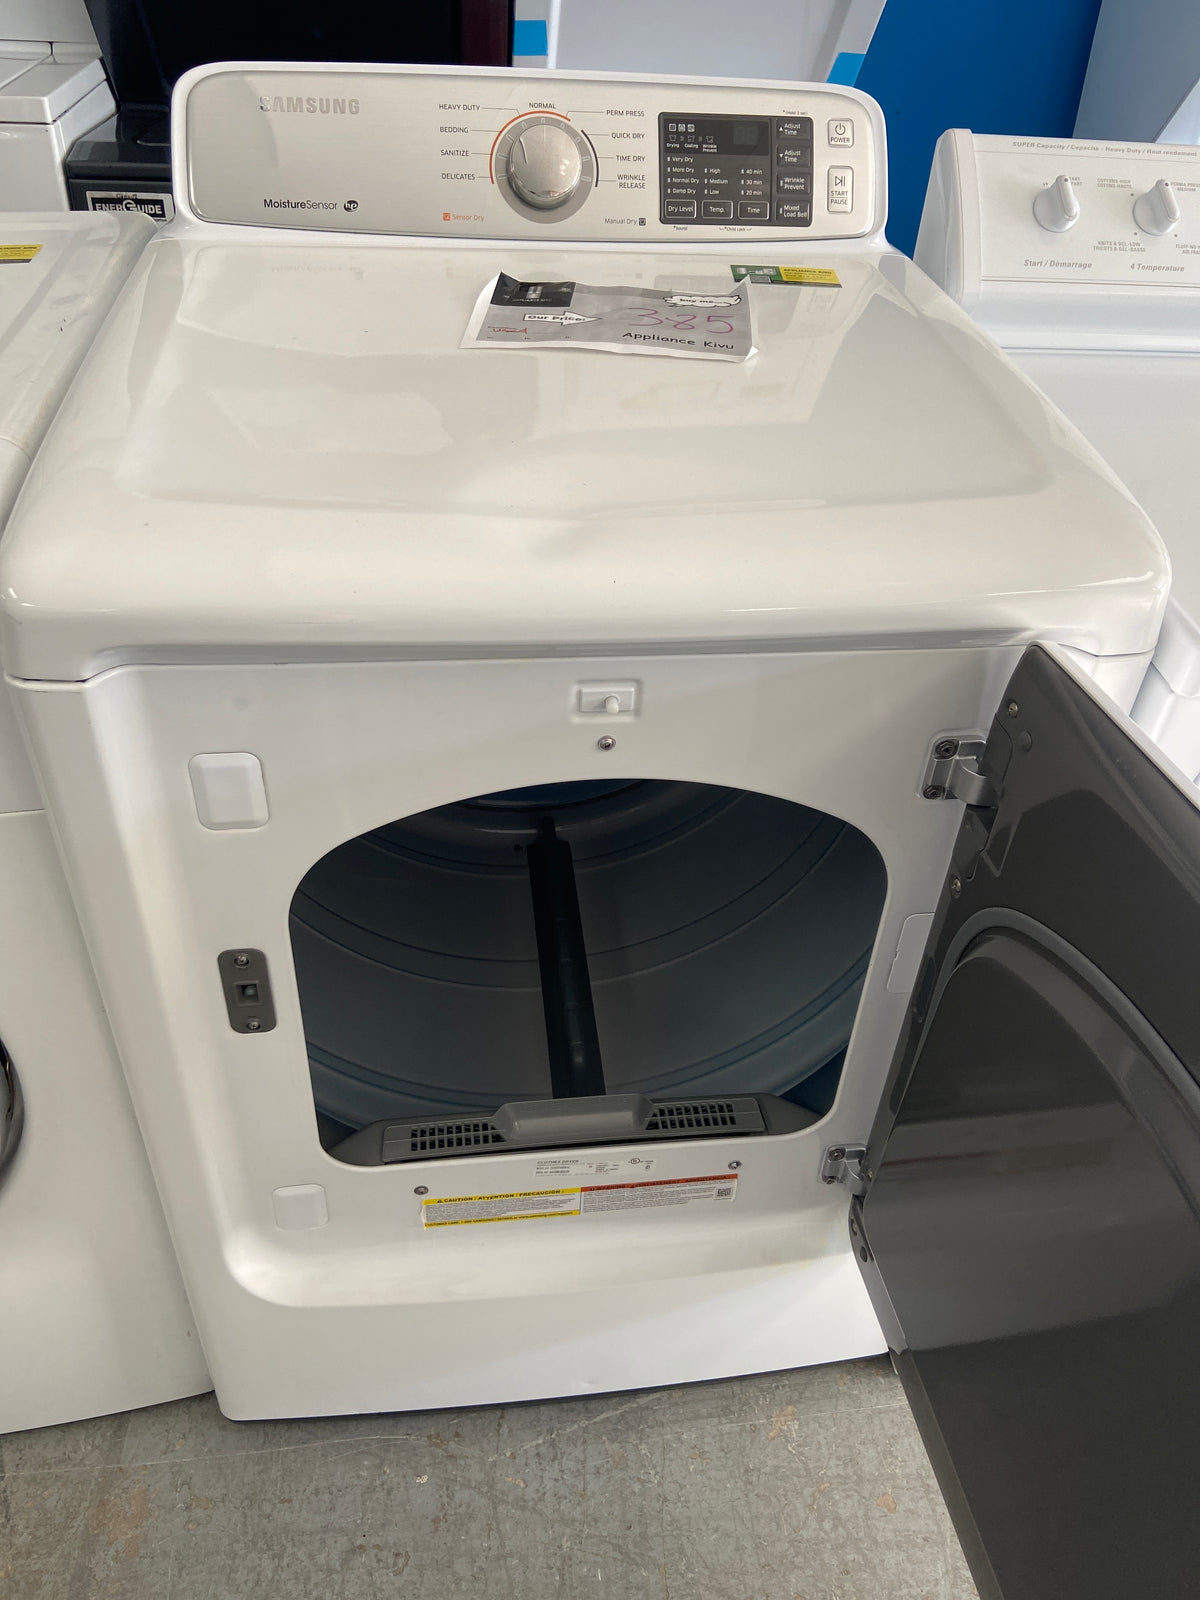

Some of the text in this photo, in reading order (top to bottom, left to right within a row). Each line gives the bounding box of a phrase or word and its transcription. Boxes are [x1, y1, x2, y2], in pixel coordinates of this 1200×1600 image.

[259, 96, 360, 114] SAMSUNG
[1036, 142, 1066, 150] Capacity
[1105, 146, 1125, 154] Heavy
[95, 199, 163, 214] ENERGUIDE
[263, 199, 338, 210] MoistureSensor
[473, 214, 485, 222] Dry
[626, 218, 637, 226] Dry
[1024, 259, 1044, 268] Start
[1050, 260, 1093, 270] Démarrage
[1137, 263, 1185, 272] Temperature
[622, 332, 735, 350] Appliance Kivu
[478, 1193, 515, 1201] ATTENTION
